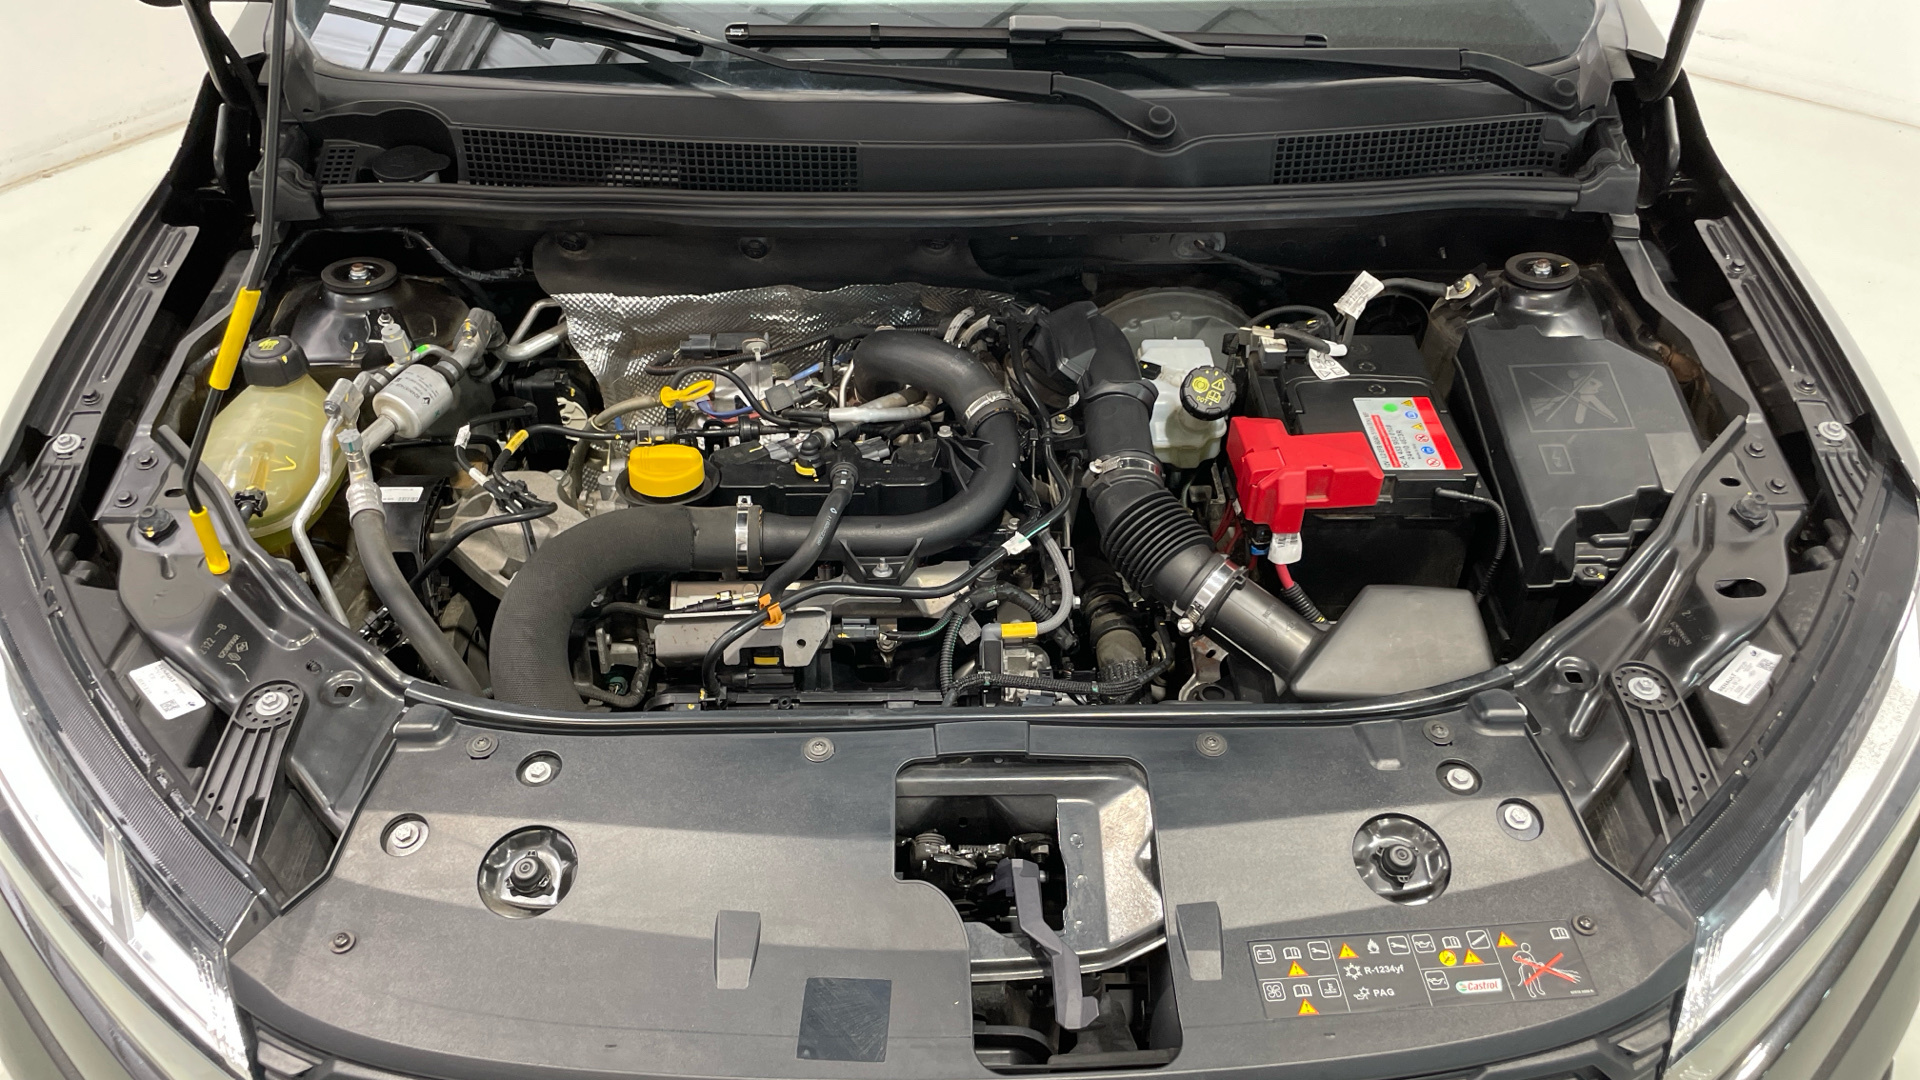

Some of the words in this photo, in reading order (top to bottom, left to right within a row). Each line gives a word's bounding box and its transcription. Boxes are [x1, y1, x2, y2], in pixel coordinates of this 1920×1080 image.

[1197, 396, 1207, 404] DOT
[1363, 964, 1405, 975] R-1234yf
[1467, 980, 1498, 991] Castrol
[1373, 988, 1395, 998] PAG
